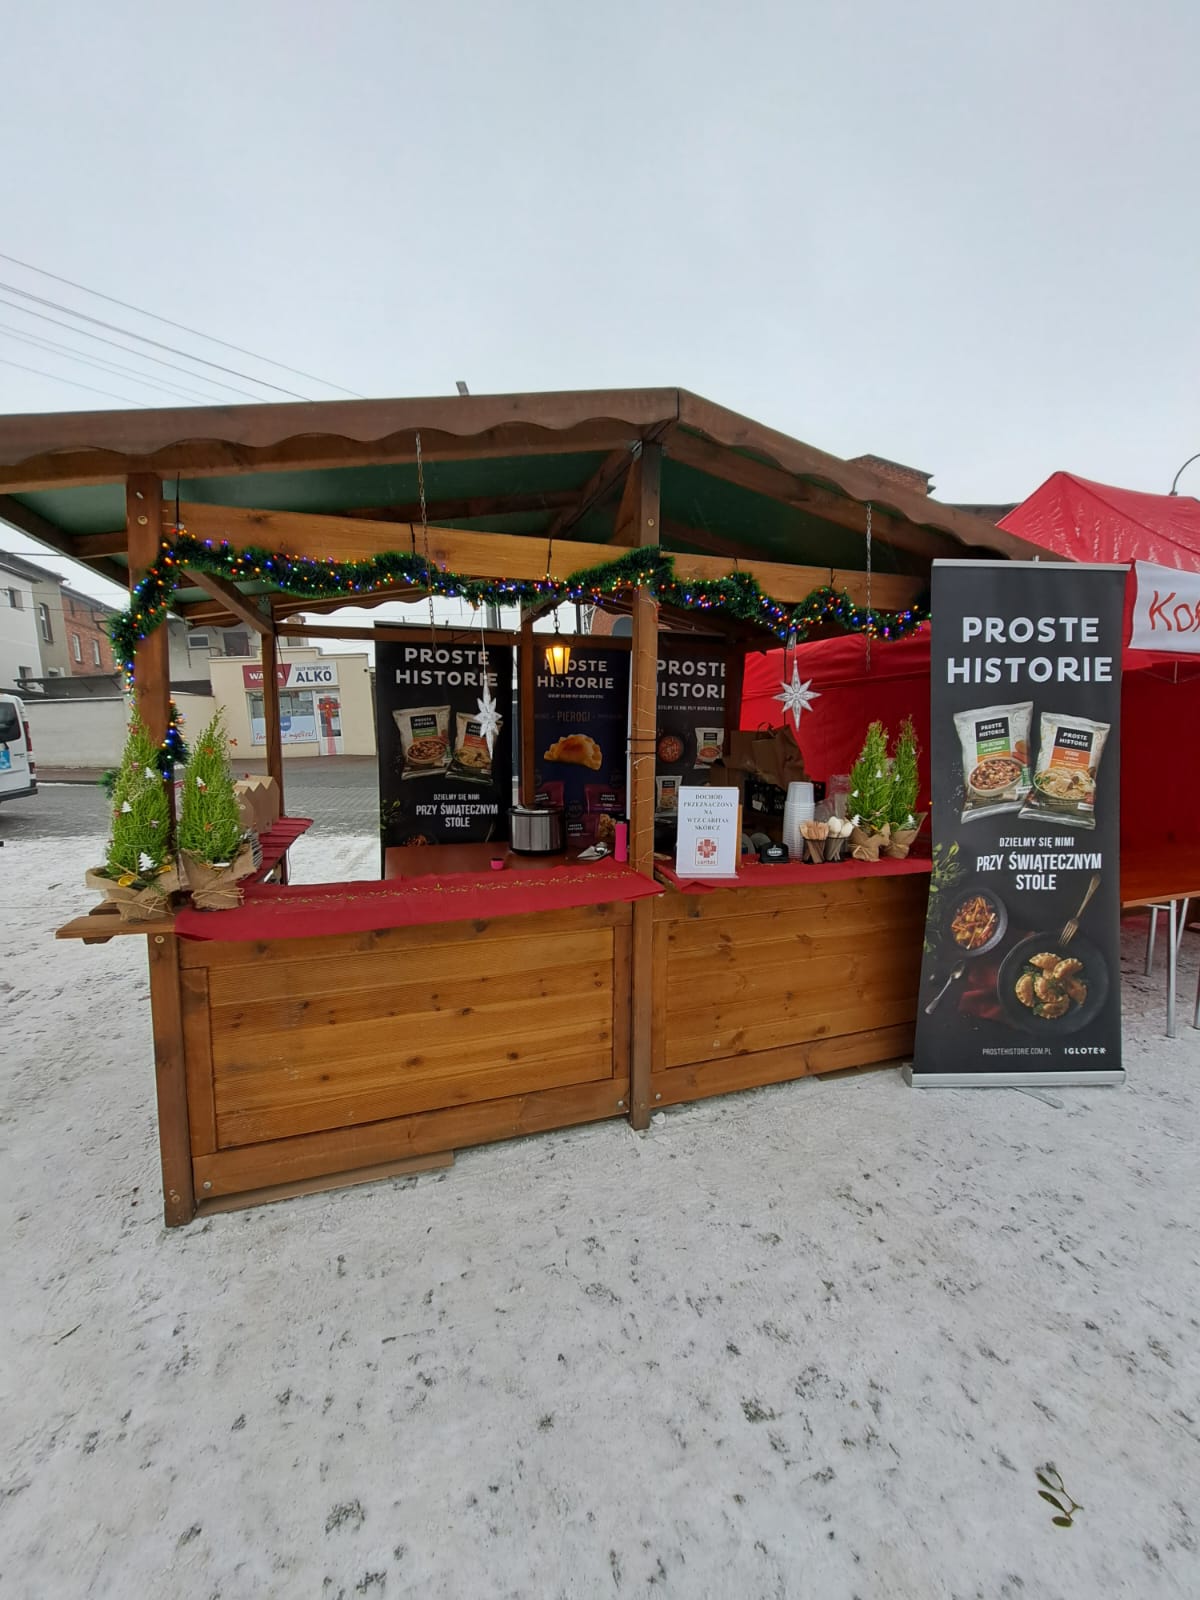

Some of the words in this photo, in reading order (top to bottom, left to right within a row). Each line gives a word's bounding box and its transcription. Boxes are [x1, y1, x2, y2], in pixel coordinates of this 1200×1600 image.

[962, 616, 1100, 643] PROSTE
[404, 647, 490, 665] PROSTE
[248, 671, 284, 681] WAA
[296, 670, 332, 683] ALKO
[947, 656, 1113, 684] HISTORIE
[395, 669, 499, 688] HISTORIE
[1063, 732, 1088, 741] PROSTE
[416, 804, 438, 816] PRZY
[440, 802, 499, 817] ŚWIĄTECZNYM
[445, 816, 471, 828] STOLE
[999, 837, 1037, 847] DZIELMY
[1038, 837, 1053, 849] SIĘ
[1054, 836, 1075, 847] NIMI
[975, 854, 1005, 872] PRZY
[1008, 851, 1102, 872] ŚWIĄTECZNYM
[1015, 874, 1057, 890] STOLE
